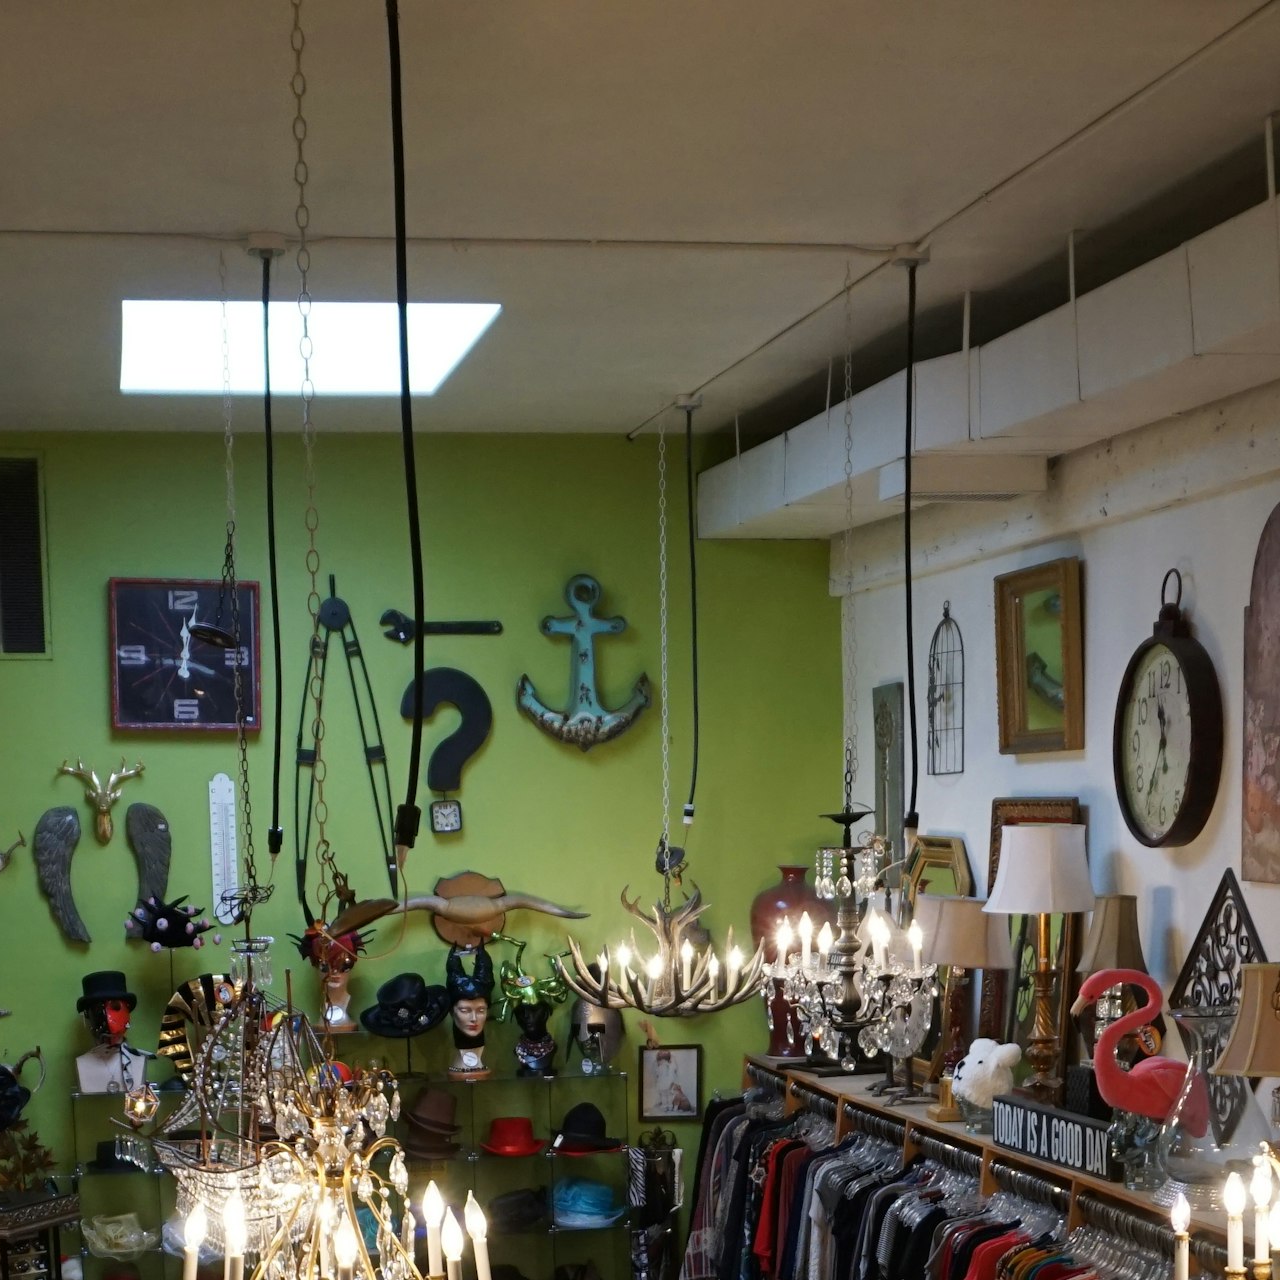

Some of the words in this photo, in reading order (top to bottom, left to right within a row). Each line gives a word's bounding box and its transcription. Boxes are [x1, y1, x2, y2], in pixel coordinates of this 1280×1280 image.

[1147, 671, 1156, 698] 11
[1159, 660, 1171, 689] 12
[1137, 697, 1148, 726] 10
[1132, 730, 1141, 760] 9
[1136, 765, 1144, 793] 8
[993, 1100, 1025, 1150] TODAY
[1026, 1110, 1038, 1154] IS
[1040, 1114, 1049, 1158] A
[1051, 1117, 1083, 1168] GOOD
[1085, 1127, 1108, 1176] DAY
